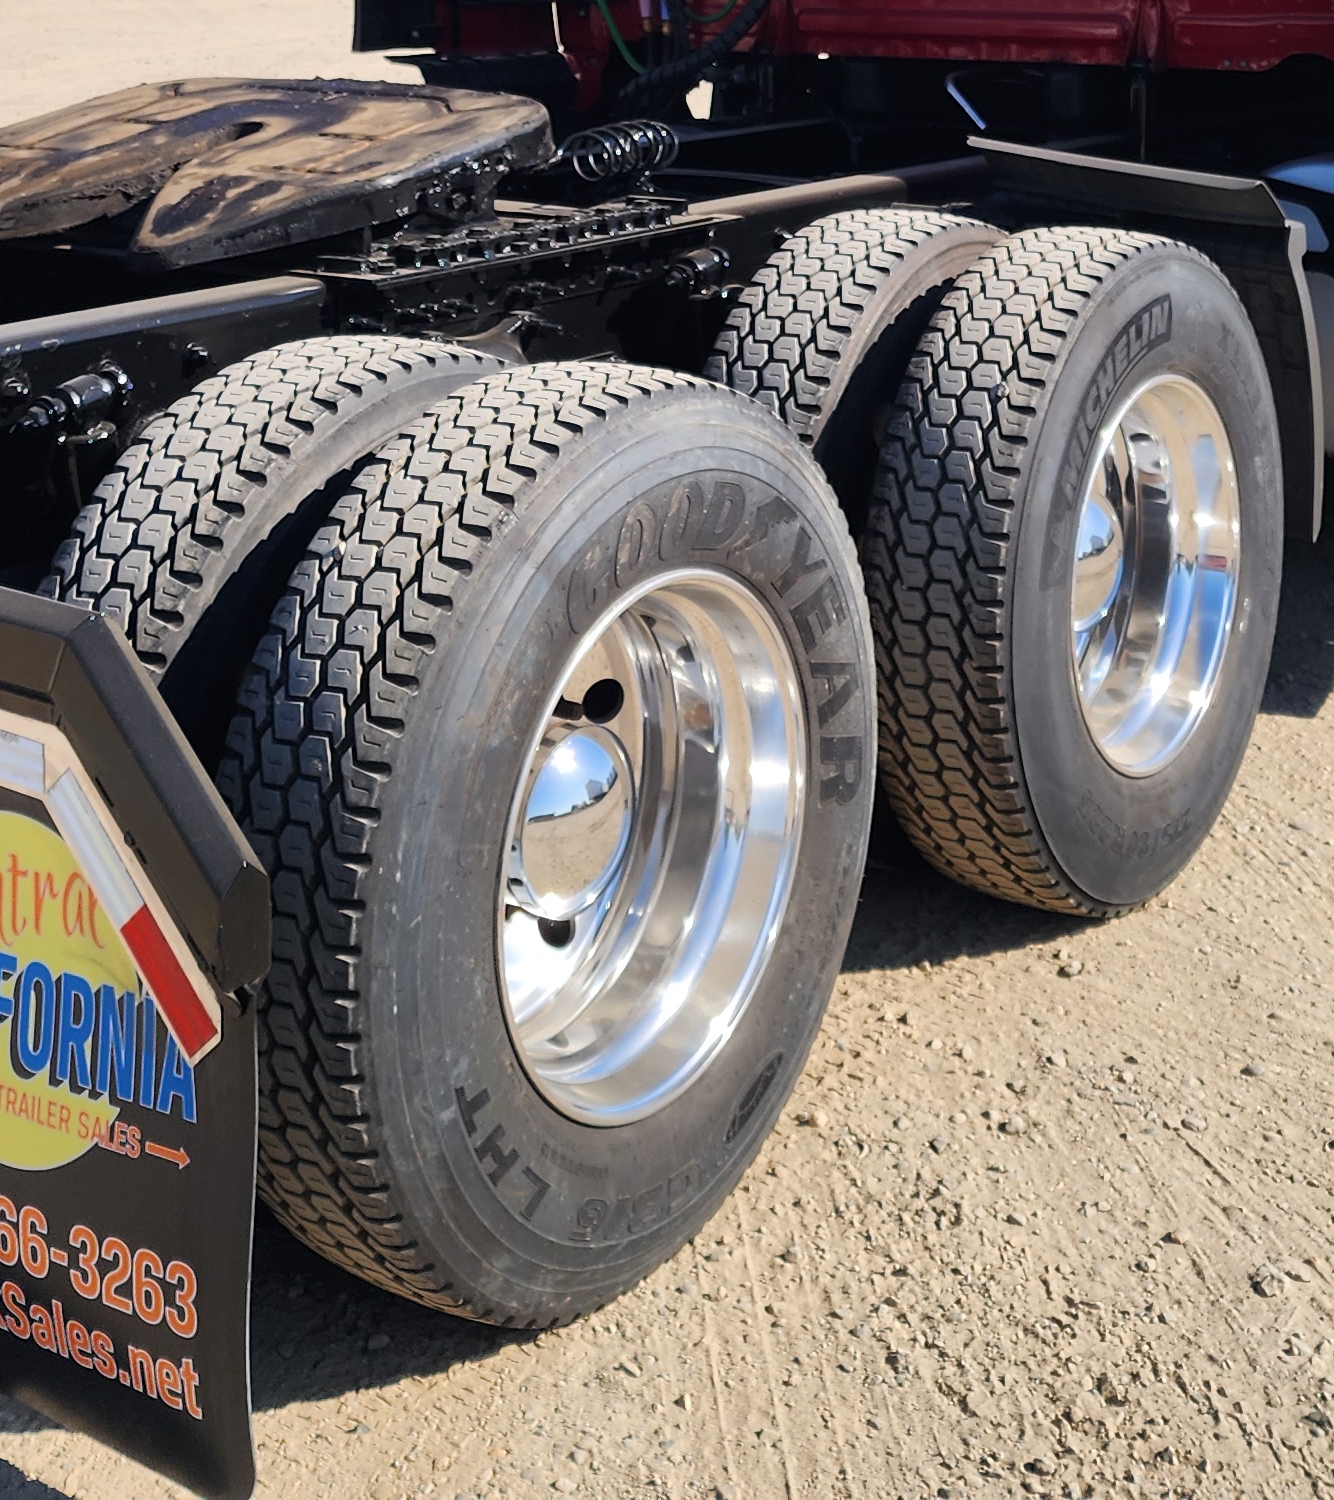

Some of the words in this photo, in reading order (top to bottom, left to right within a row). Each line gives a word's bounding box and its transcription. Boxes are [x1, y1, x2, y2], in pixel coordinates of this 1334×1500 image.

[1061, 301, 1169, 499] MICHELIN
[567, 480, 863, 806] GOODYEAR
[78, 1111, 142, 1158] SALES
[454, 1086, 552, 1221] LHT
